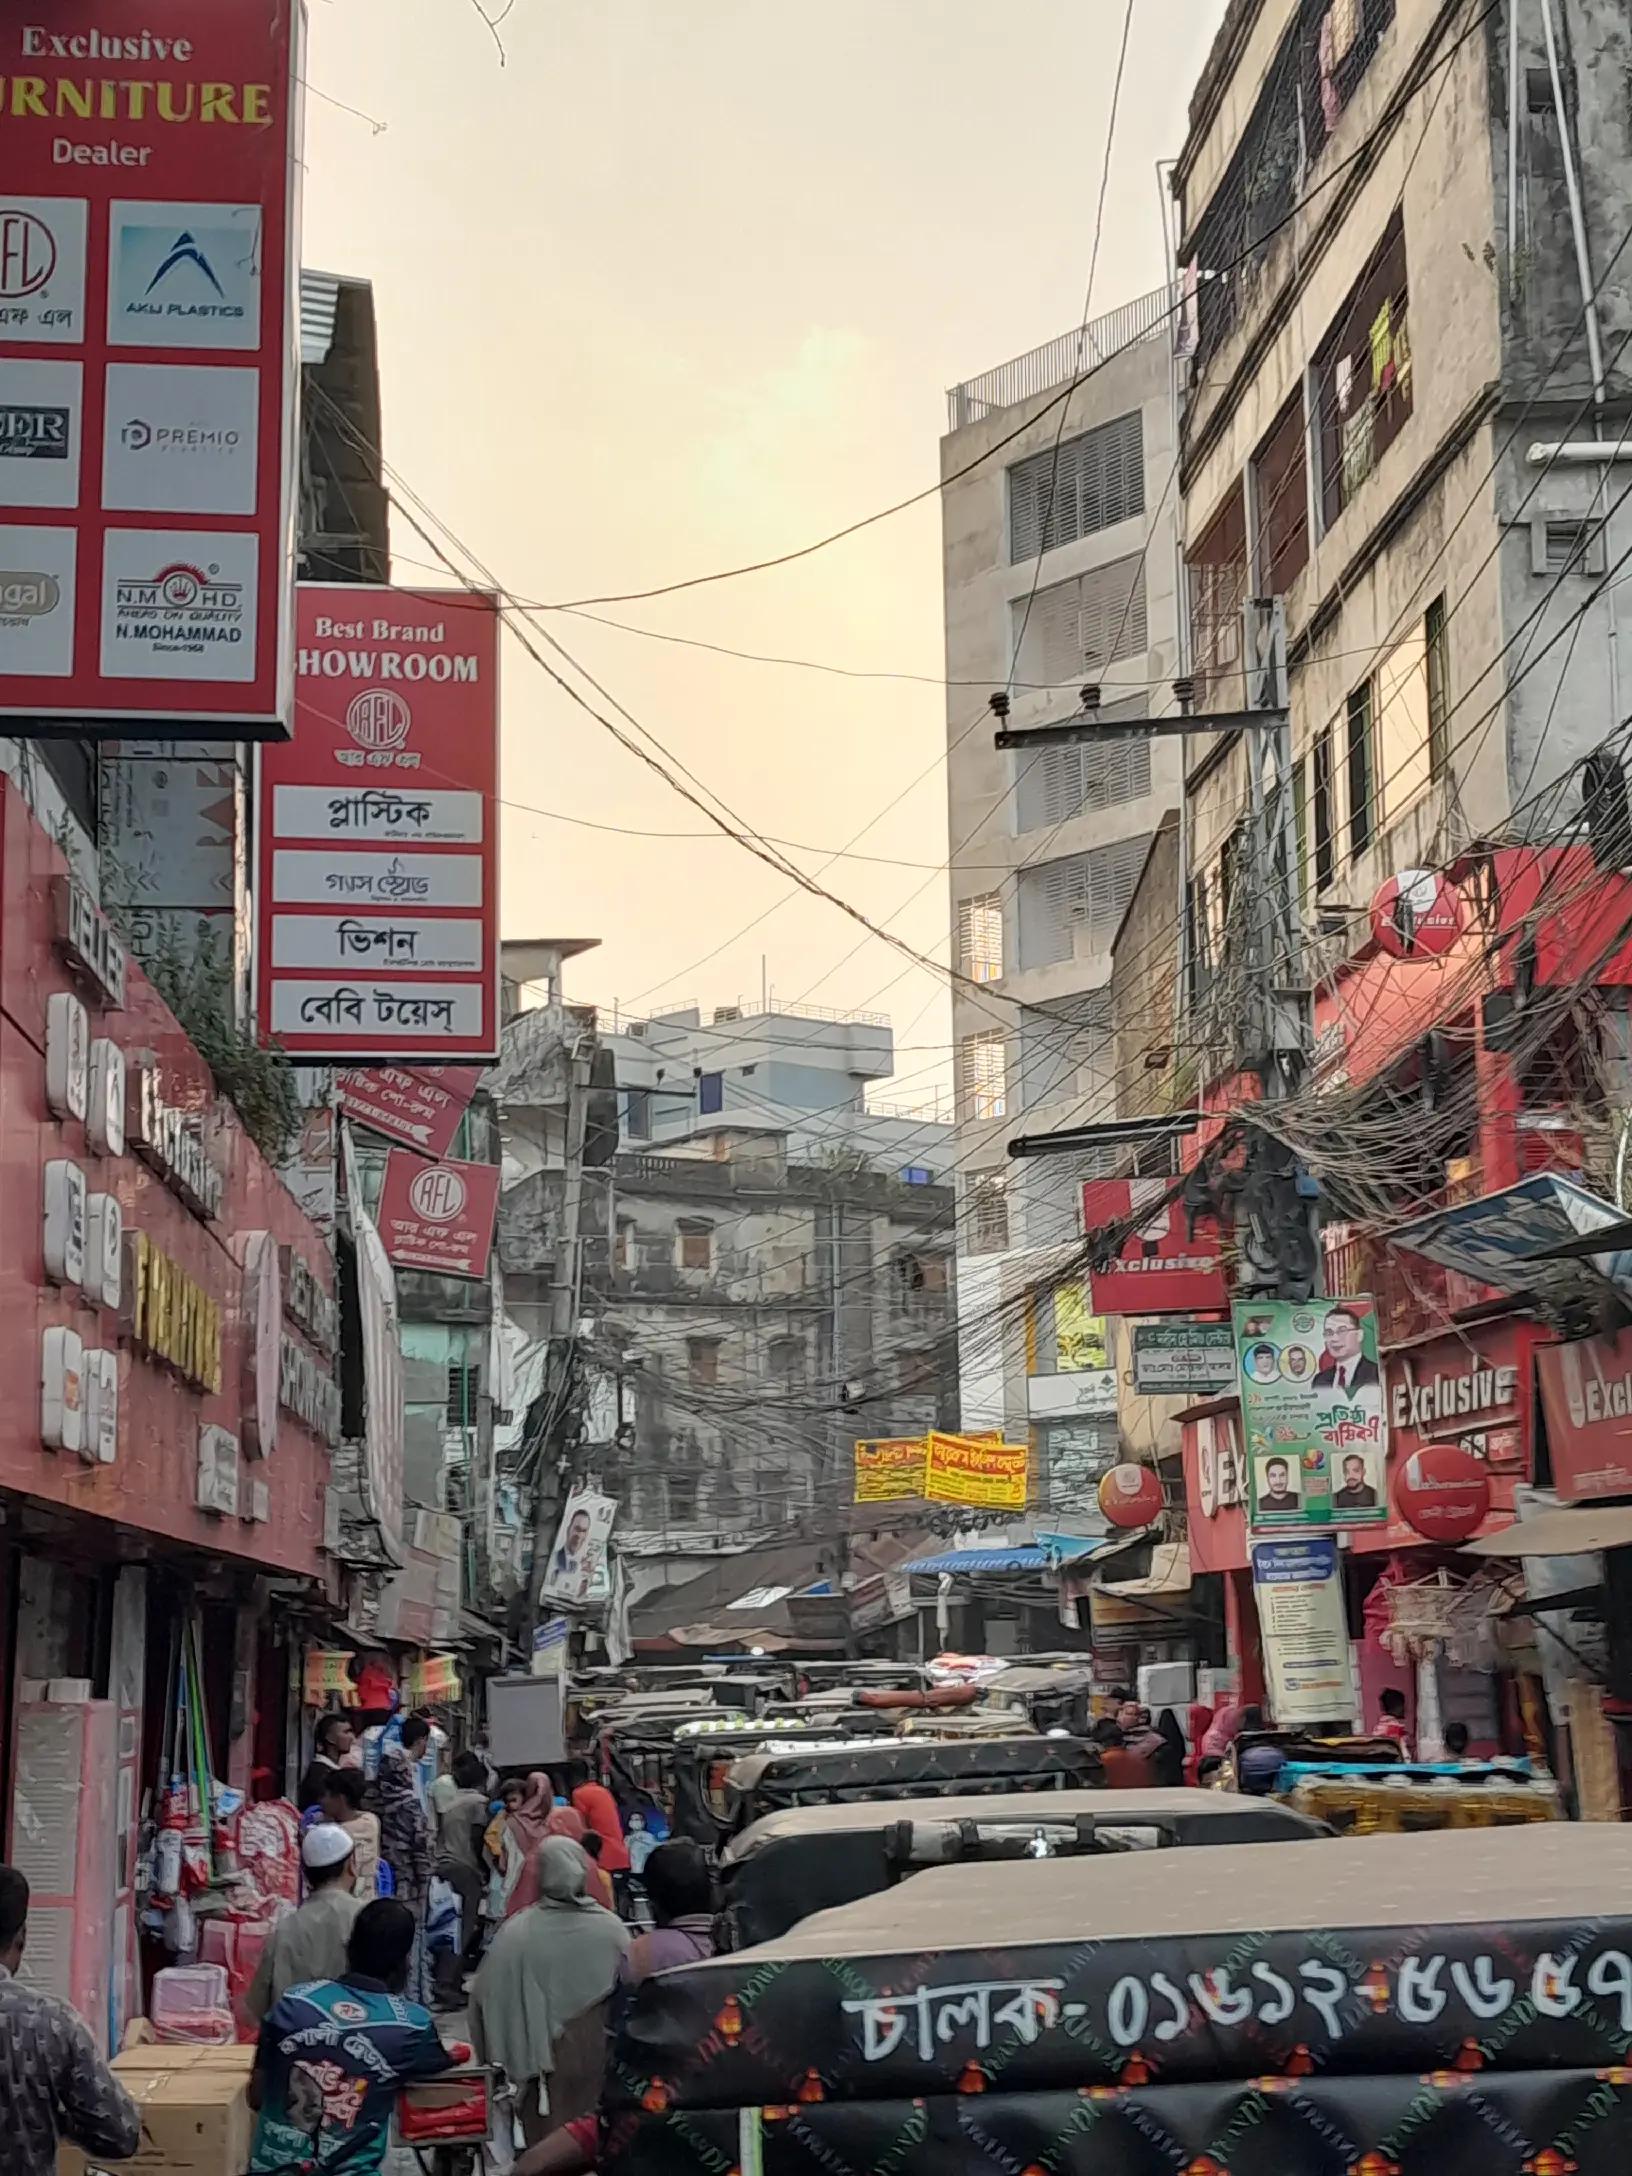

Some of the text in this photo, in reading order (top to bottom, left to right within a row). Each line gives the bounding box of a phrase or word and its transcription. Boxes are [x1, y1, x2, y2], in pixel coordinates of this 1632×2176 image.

[22, 26, 194, 61] Exclusive
[0, 74, 274, 124] RNITURE
[53, 138, 153, 166] Dealer
[167, 304, 244, 318] PLASTICS
[156, 428, 239, 446] PREMIO
[314, 617, 445, 643] Best Brand
[294, 649, 478, 682] HOWROOM
[328, 790, 433, 828] প্লাস্টিক
[335, 919, 421, 957] ভিশন
[300, 987, 367, 1024] বেবি
[419, 1174, 456, 1214] RFL
[1101, 1253, 1216, 1274] xclusive
